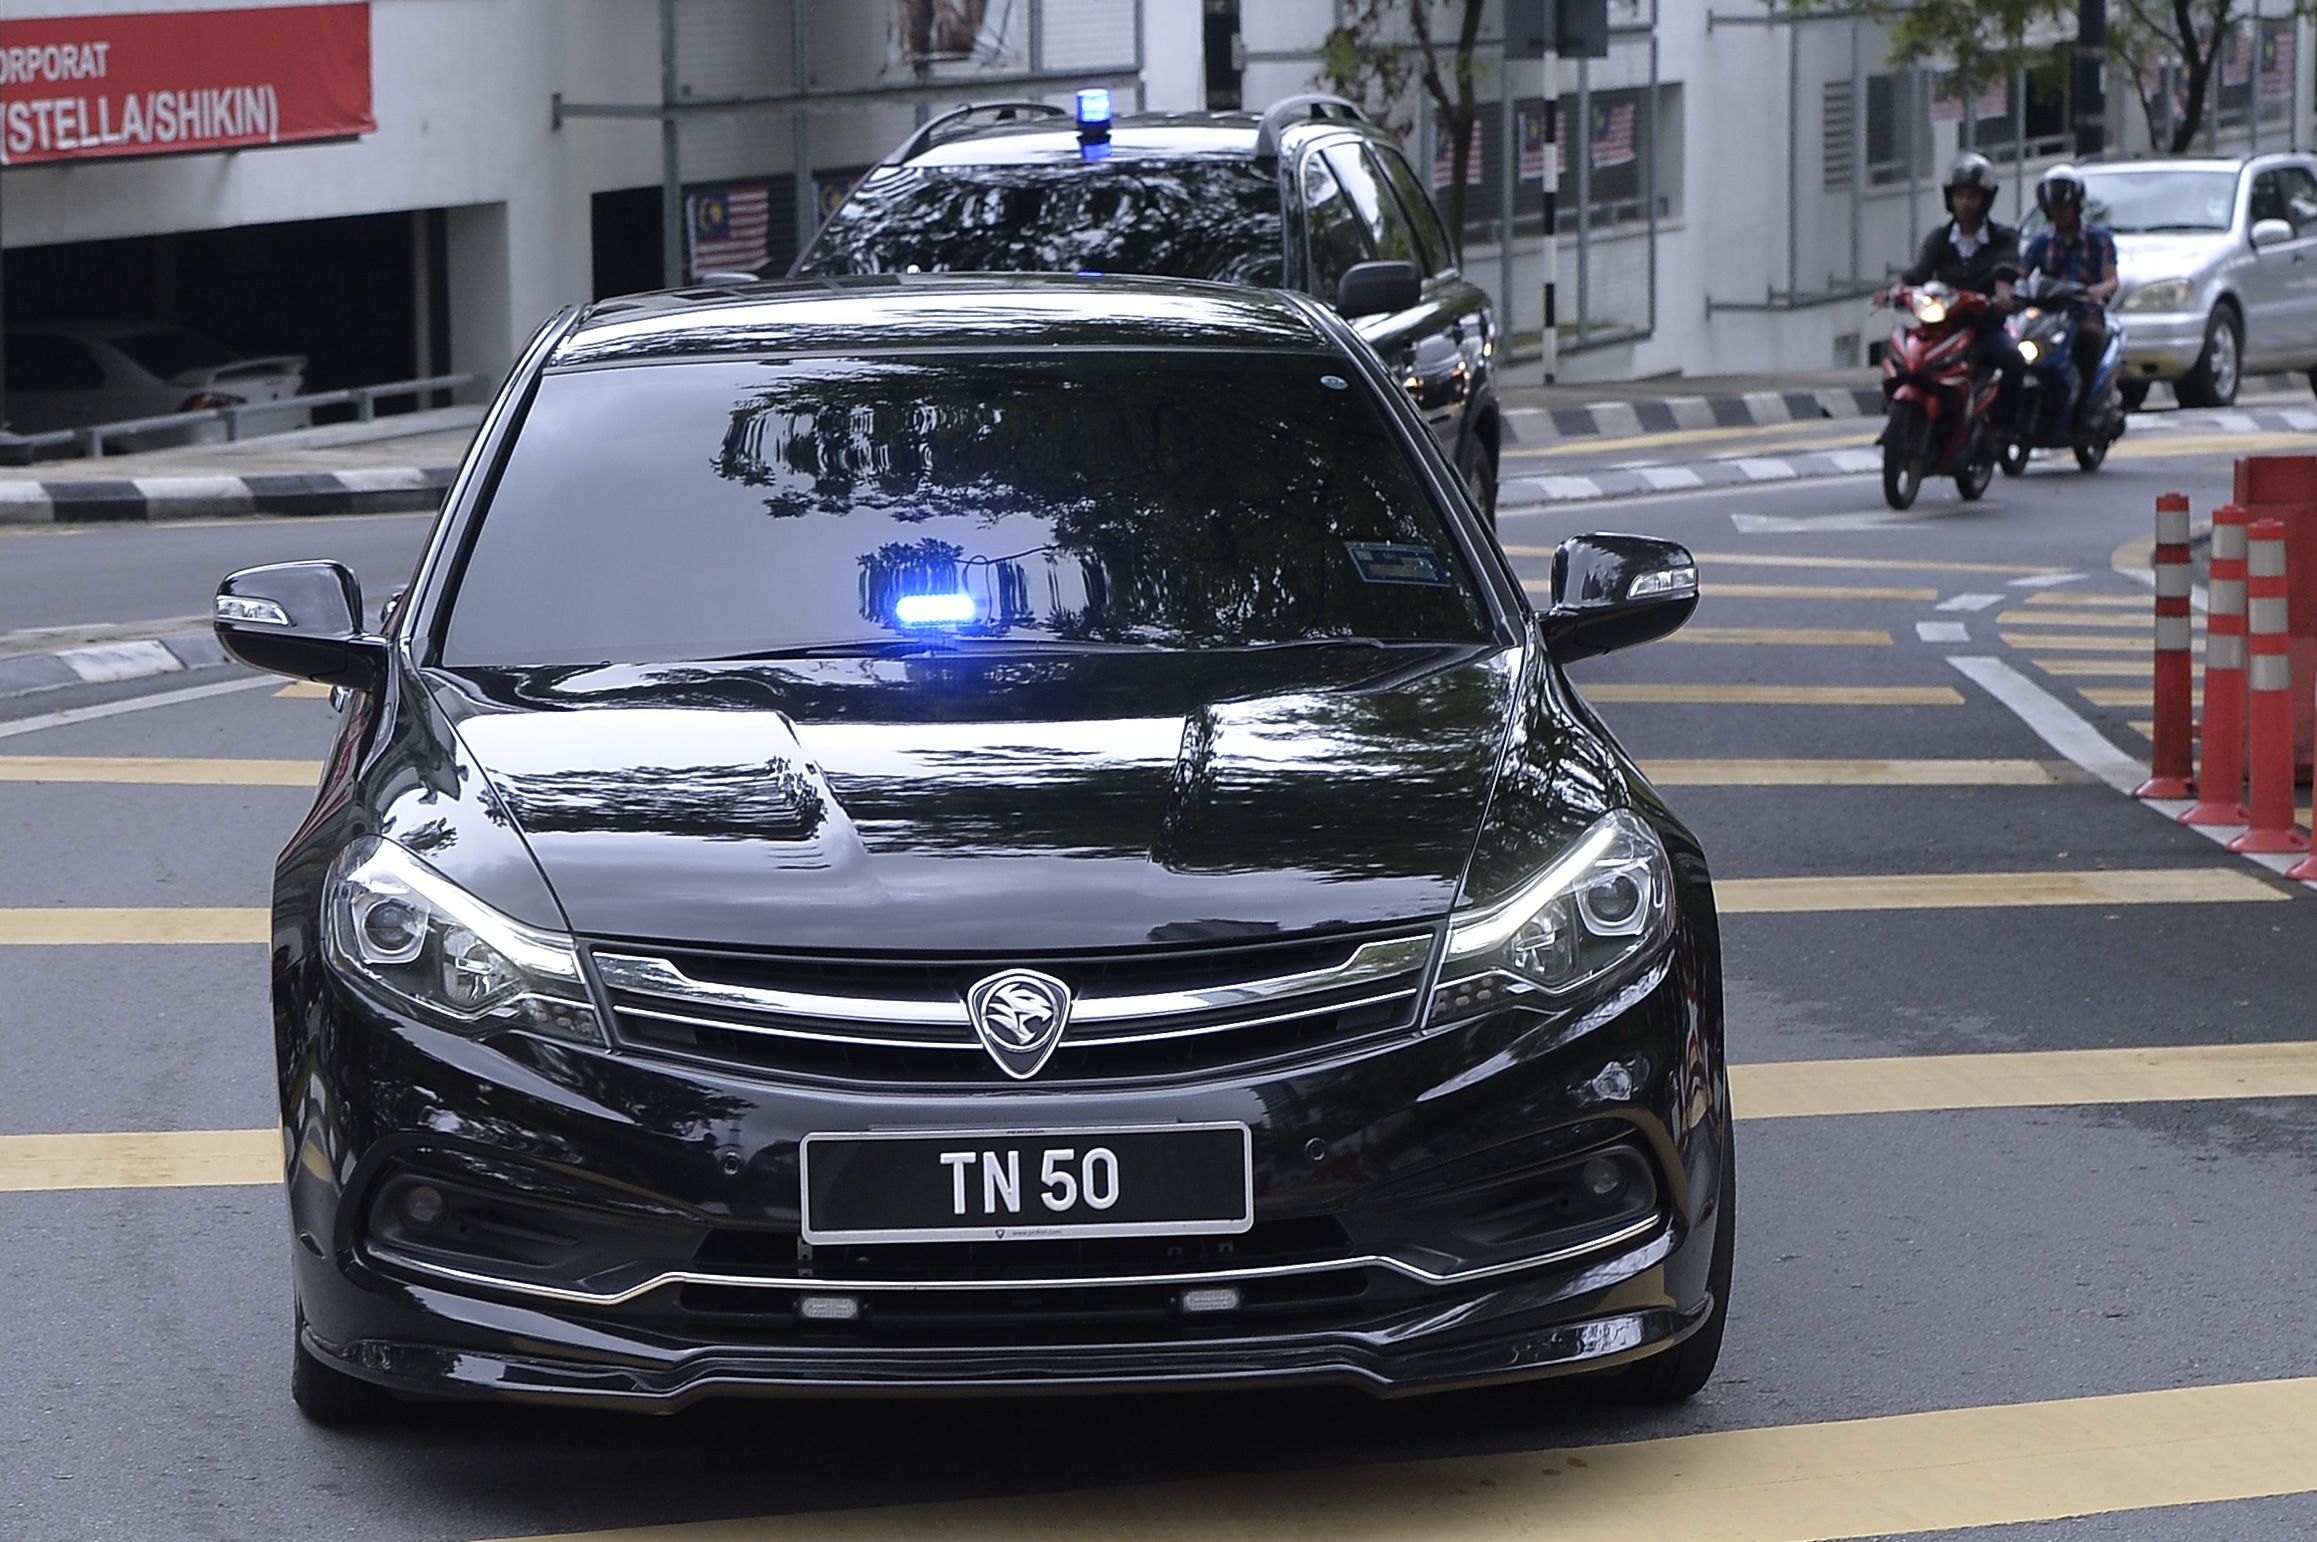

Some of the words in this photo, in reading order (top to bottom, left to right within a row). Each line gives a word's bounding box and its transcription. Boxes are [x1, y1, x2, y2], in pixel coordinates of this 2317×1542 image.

[0, 84, 279, 165] (STELLA/SHIKIN)
[940, 1150, 1020, 1215] TN
[1041, 1147, 1120, 1212] 50
